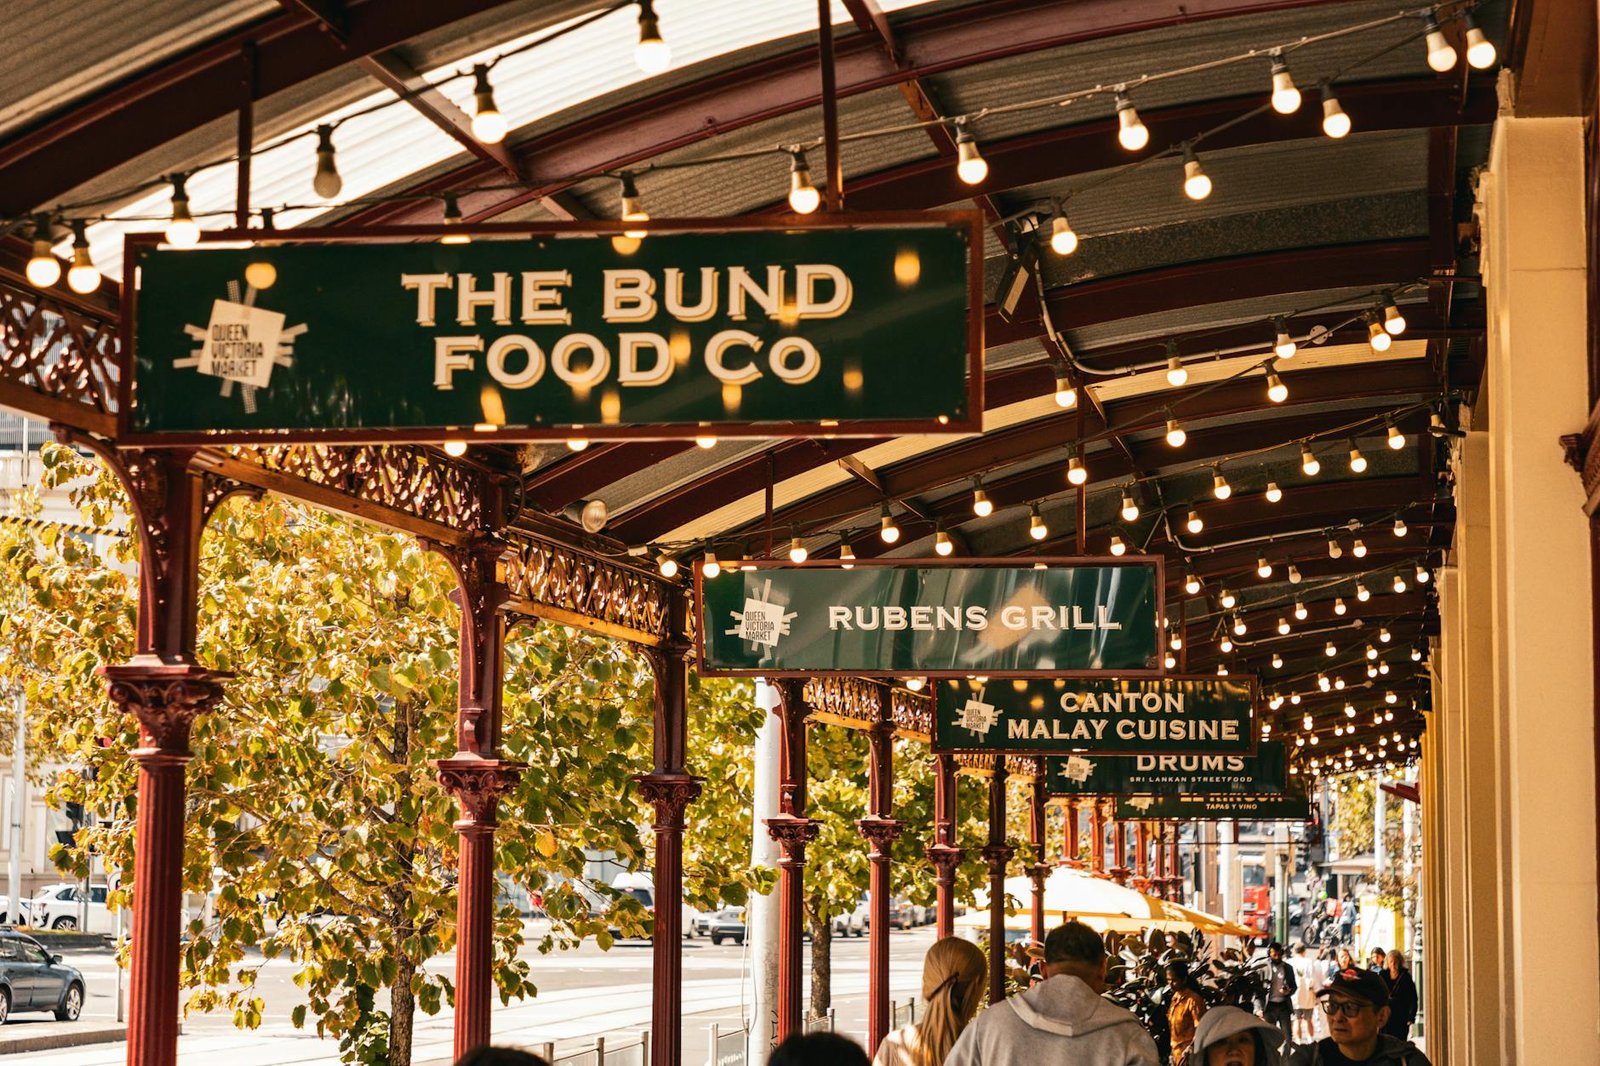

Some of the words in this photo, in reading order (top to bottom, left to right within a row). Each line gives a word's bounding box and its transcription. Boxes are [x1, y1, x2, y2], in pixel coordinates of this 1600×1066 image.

[401, 268, 572, 327] THE
[602, 263, 853, 324] BUND
[211, 323, 250, 341] QUEEN
[211, 341, 264, 359] VICTORIA
[211, 359, 258, 377] MARKET
[434, 331, 675, 390] FOOD
[745, 611, 766, 621] QUEEN
[828, 605, 988, 631] RUBENS
[1000, 605, 1122, 631] GRILL
[745, 621, 775, 631] VICTORIA
[745, 631, 771, 641] MARKET
[1060, 692, 1185, 714] CANTON
[1007, 718, 1108, 740] MALAY
[1116, 719, 1240, 741] CUISINE
[1136, 755, 1245, 772] DRUMS
